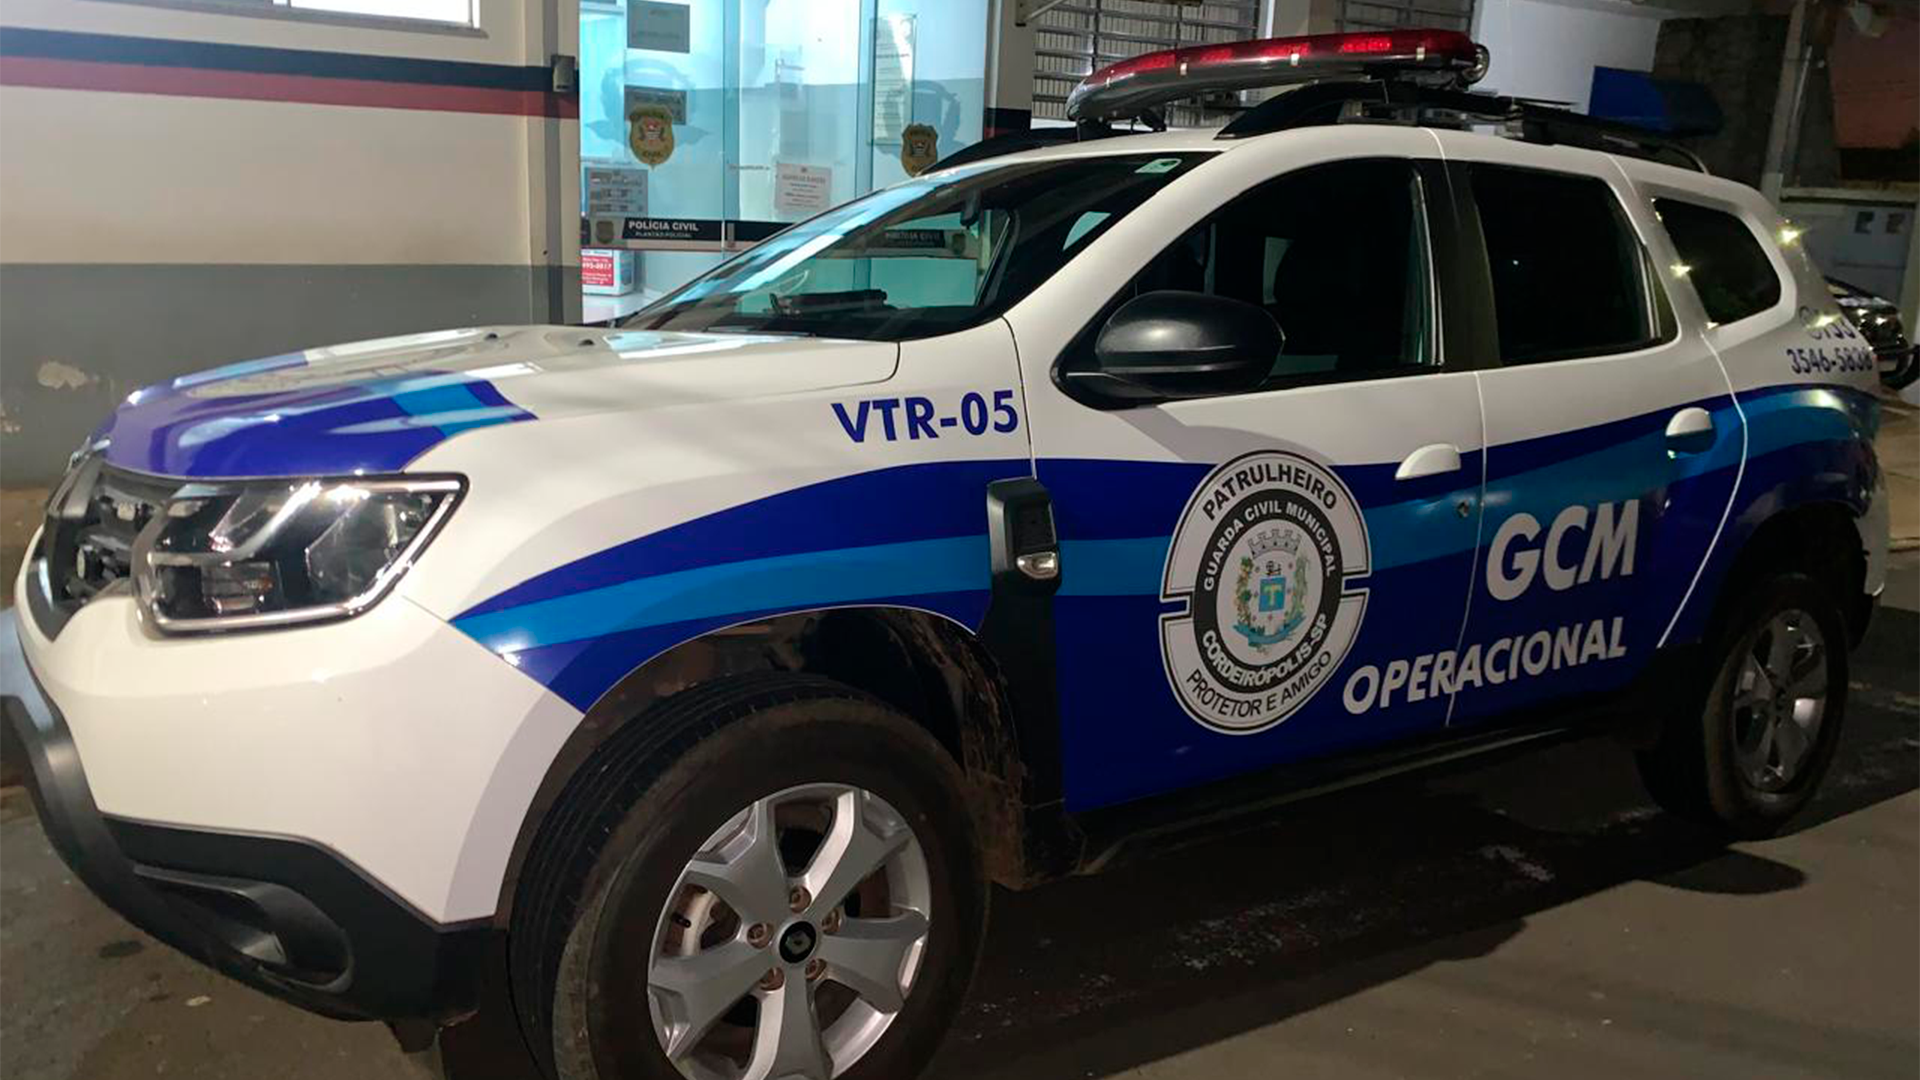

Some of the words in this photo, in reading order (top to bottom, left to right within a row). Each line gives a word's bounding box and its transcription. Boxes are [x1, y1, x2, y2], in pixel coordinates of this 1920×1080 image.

[628, 219, 670, 230] POLÍCIA
[672, 221, 699, 231] CIVIL
[831, 390, 1018, 443] VTR-05
[1202, 463, 1337, 521] PATRULHEIRO
[1204, 517, 1245, 591] GUARDA
[1244, 500, 1282, 521] CIVIL
[1286, 501, 1337, 577] MUNICIPAL
[1486, 499, 1639, 601] GCM
[1186, 668, 1262, 717] PROTETOR
[1266, 693, 1278, 712] E
[1281, 651, 1331, 701] AMIGO
[1342, 617, 1627, 715] OPERACIONAL
